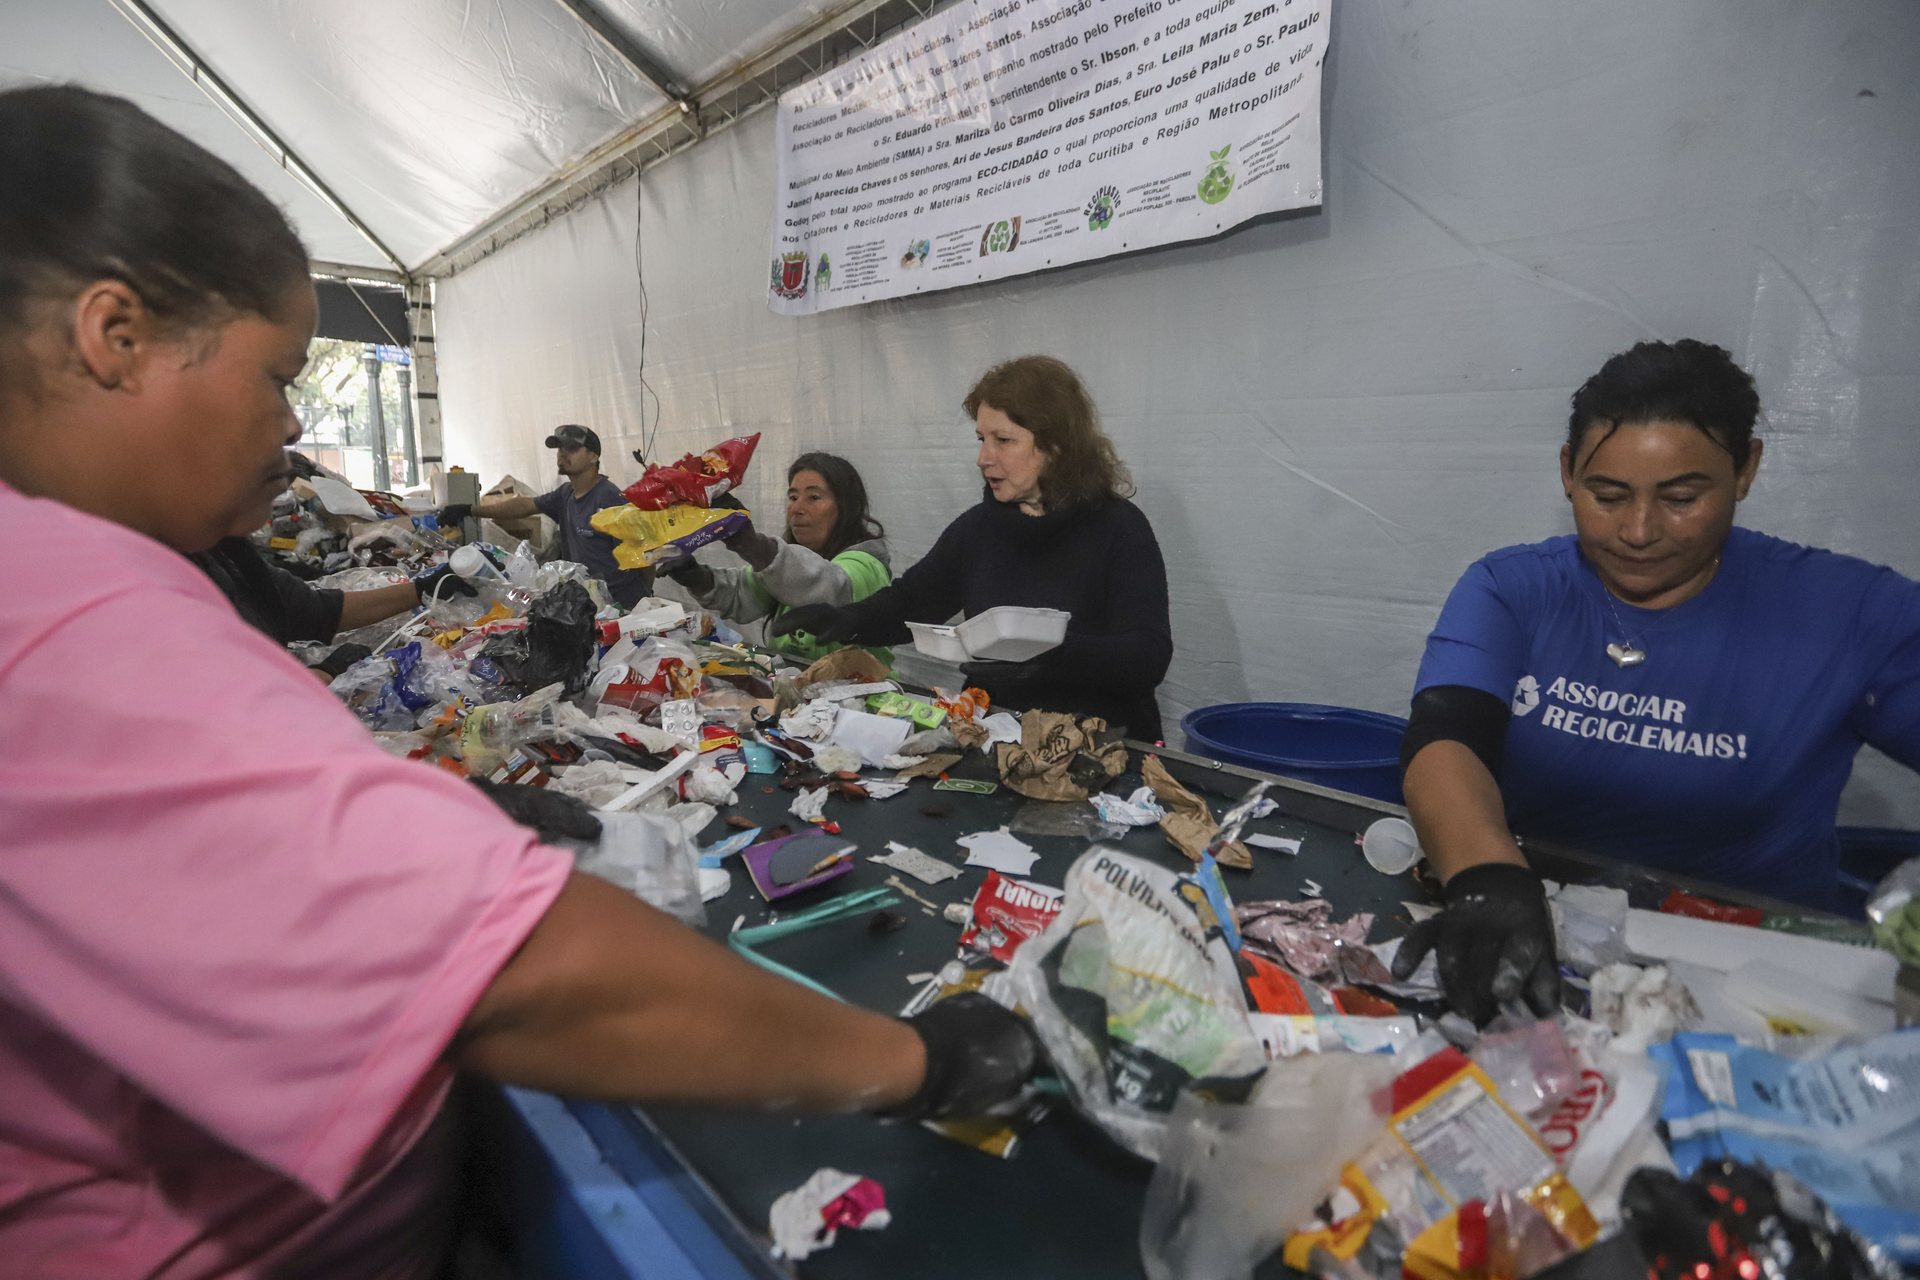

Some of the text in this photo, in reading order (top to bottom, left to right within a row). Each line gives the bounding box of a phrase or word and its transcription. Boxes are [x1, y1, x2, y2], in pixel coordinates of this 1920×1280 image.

[792, 113, 838, 133] Recicladores
[929, 48, 981, 77] Recicladores
[986, 29, 1026, 53] Santos,
[1031, 0, 1092, 32] Associação
[792, 134, 832, 153] Associação
[834, 131, 844, 140] de
[846, 115, 893, 136] Recicladores
[983, 58, 1026, 82] empenho
[1029, 35, 1079, 63] mostrado
[1083, 22, 1109, 43] pelo
[1114, 1, 1162, 28] Prefeito
[881, 135, 892, 145] Sr.
[895, 122, 932, 141] Eduardo
[990, 69, 1067, 107] superintendente
[1070, 66, 1078, 76] o
[1081, 58, 1097, 72] Sr.
[1101, 42, 1140, 64] Ibson,
[1143, 36, 1150, 46] e
[1154, 32, 1161, 41] a
[1165, 17, 1191, 36] toda
[1195, 0, 1235, 23] equipe
[968, 1, 1021, 32] Associação
[811, 211, 826, 222] pelo
[830, 206, 848, 217] total
[852, 202, 873, 213] apoio
[876, 190, 914, 206] mostrado
[918, 187, 928, 197] ao
[932, 175, 972, 193] programa
[977, 149, 1048, 180] ECO-CIDADÃO
[1053, 146, 1061, 155] o
[1065, 136, 1087, 152] qual
[1092, 111, 1158, 144] proporciona
[1164, 100, 1188, 116] uma
[1195, 71, 1256, 103] qualidade
[1264, 61, 1281, 76] de
[1289, 43, 1313, 65] vida
[814, 186, 859, 201] Aparecida
[861, 177, 891, 191] Chaves
[892, 175, 898, 183] e
[899, 172, 908, 181] os
[910, 161, 950, 178] senhores,
[952, 153, 967, 166] Ari
[969, 151, 981, 161] de
[983, 141, 1013, 157] Jesus
[1016, 123, 1062, 146] Bandeira
[1065, 114, 1085, 128] dos
[1088, 97, 1131, 120] Santos,
[1134, 84, 1162, 102] Euro
[1166, 67, 1197, 89] José
[1201, 53, 1231, 75] Palu
[1233, 49, 1240, 59] e
[1243, 43, 1252, 54] o
[1256, 34, 1274, 49] Sr.
[1278, 11, 1320, 40] Paulo
[822, 172, 833, 180] do
[835, 168, 854, 178] Meio
[855, 157, 890, 173] Ambiente
[892, 146, 925, 164] (SMMA)
[927, 144, 933, 153] a
[935, 139, 952, 151] Sra.
[955, 128, 990, 145] Marilza
[993, 122, 1006, 133] do
[1009, 107, 1044, 126] Carmo
[1048, 89, 1090, 112] Oliveira
[1095, 77, 1122, 94] Dias,
[1126, 71, 1133, 80] a
[1137, 61, 1157, 76] Sra.
[1162, 43, 1194, 64] Leila
[1199, 21, 1238, 48] Maria
[1243, 3, 1280, 27] Zem,
[782, 234, 799, 243] aos
[843, 223, 849, 231] e
[853, 209, 908, 228] Recicladores
[913, 205, 924, 215] de
[929, 193, 970, 211] Materiais
[976, 174, 1031, 198] Recicláveis
[1038, 169, 1051, 180] de
[1058, 159, 1081, 174] toda
[1088, 141, 1134, 163] Curitiba
[1142, 136, 1149, 146] e
[1156, 116, 1199, 140] Região
[1541, 704, 1748, 760] RECICLEMAIS!
[1546, 675, 1687, 724] ASSOCIAR
